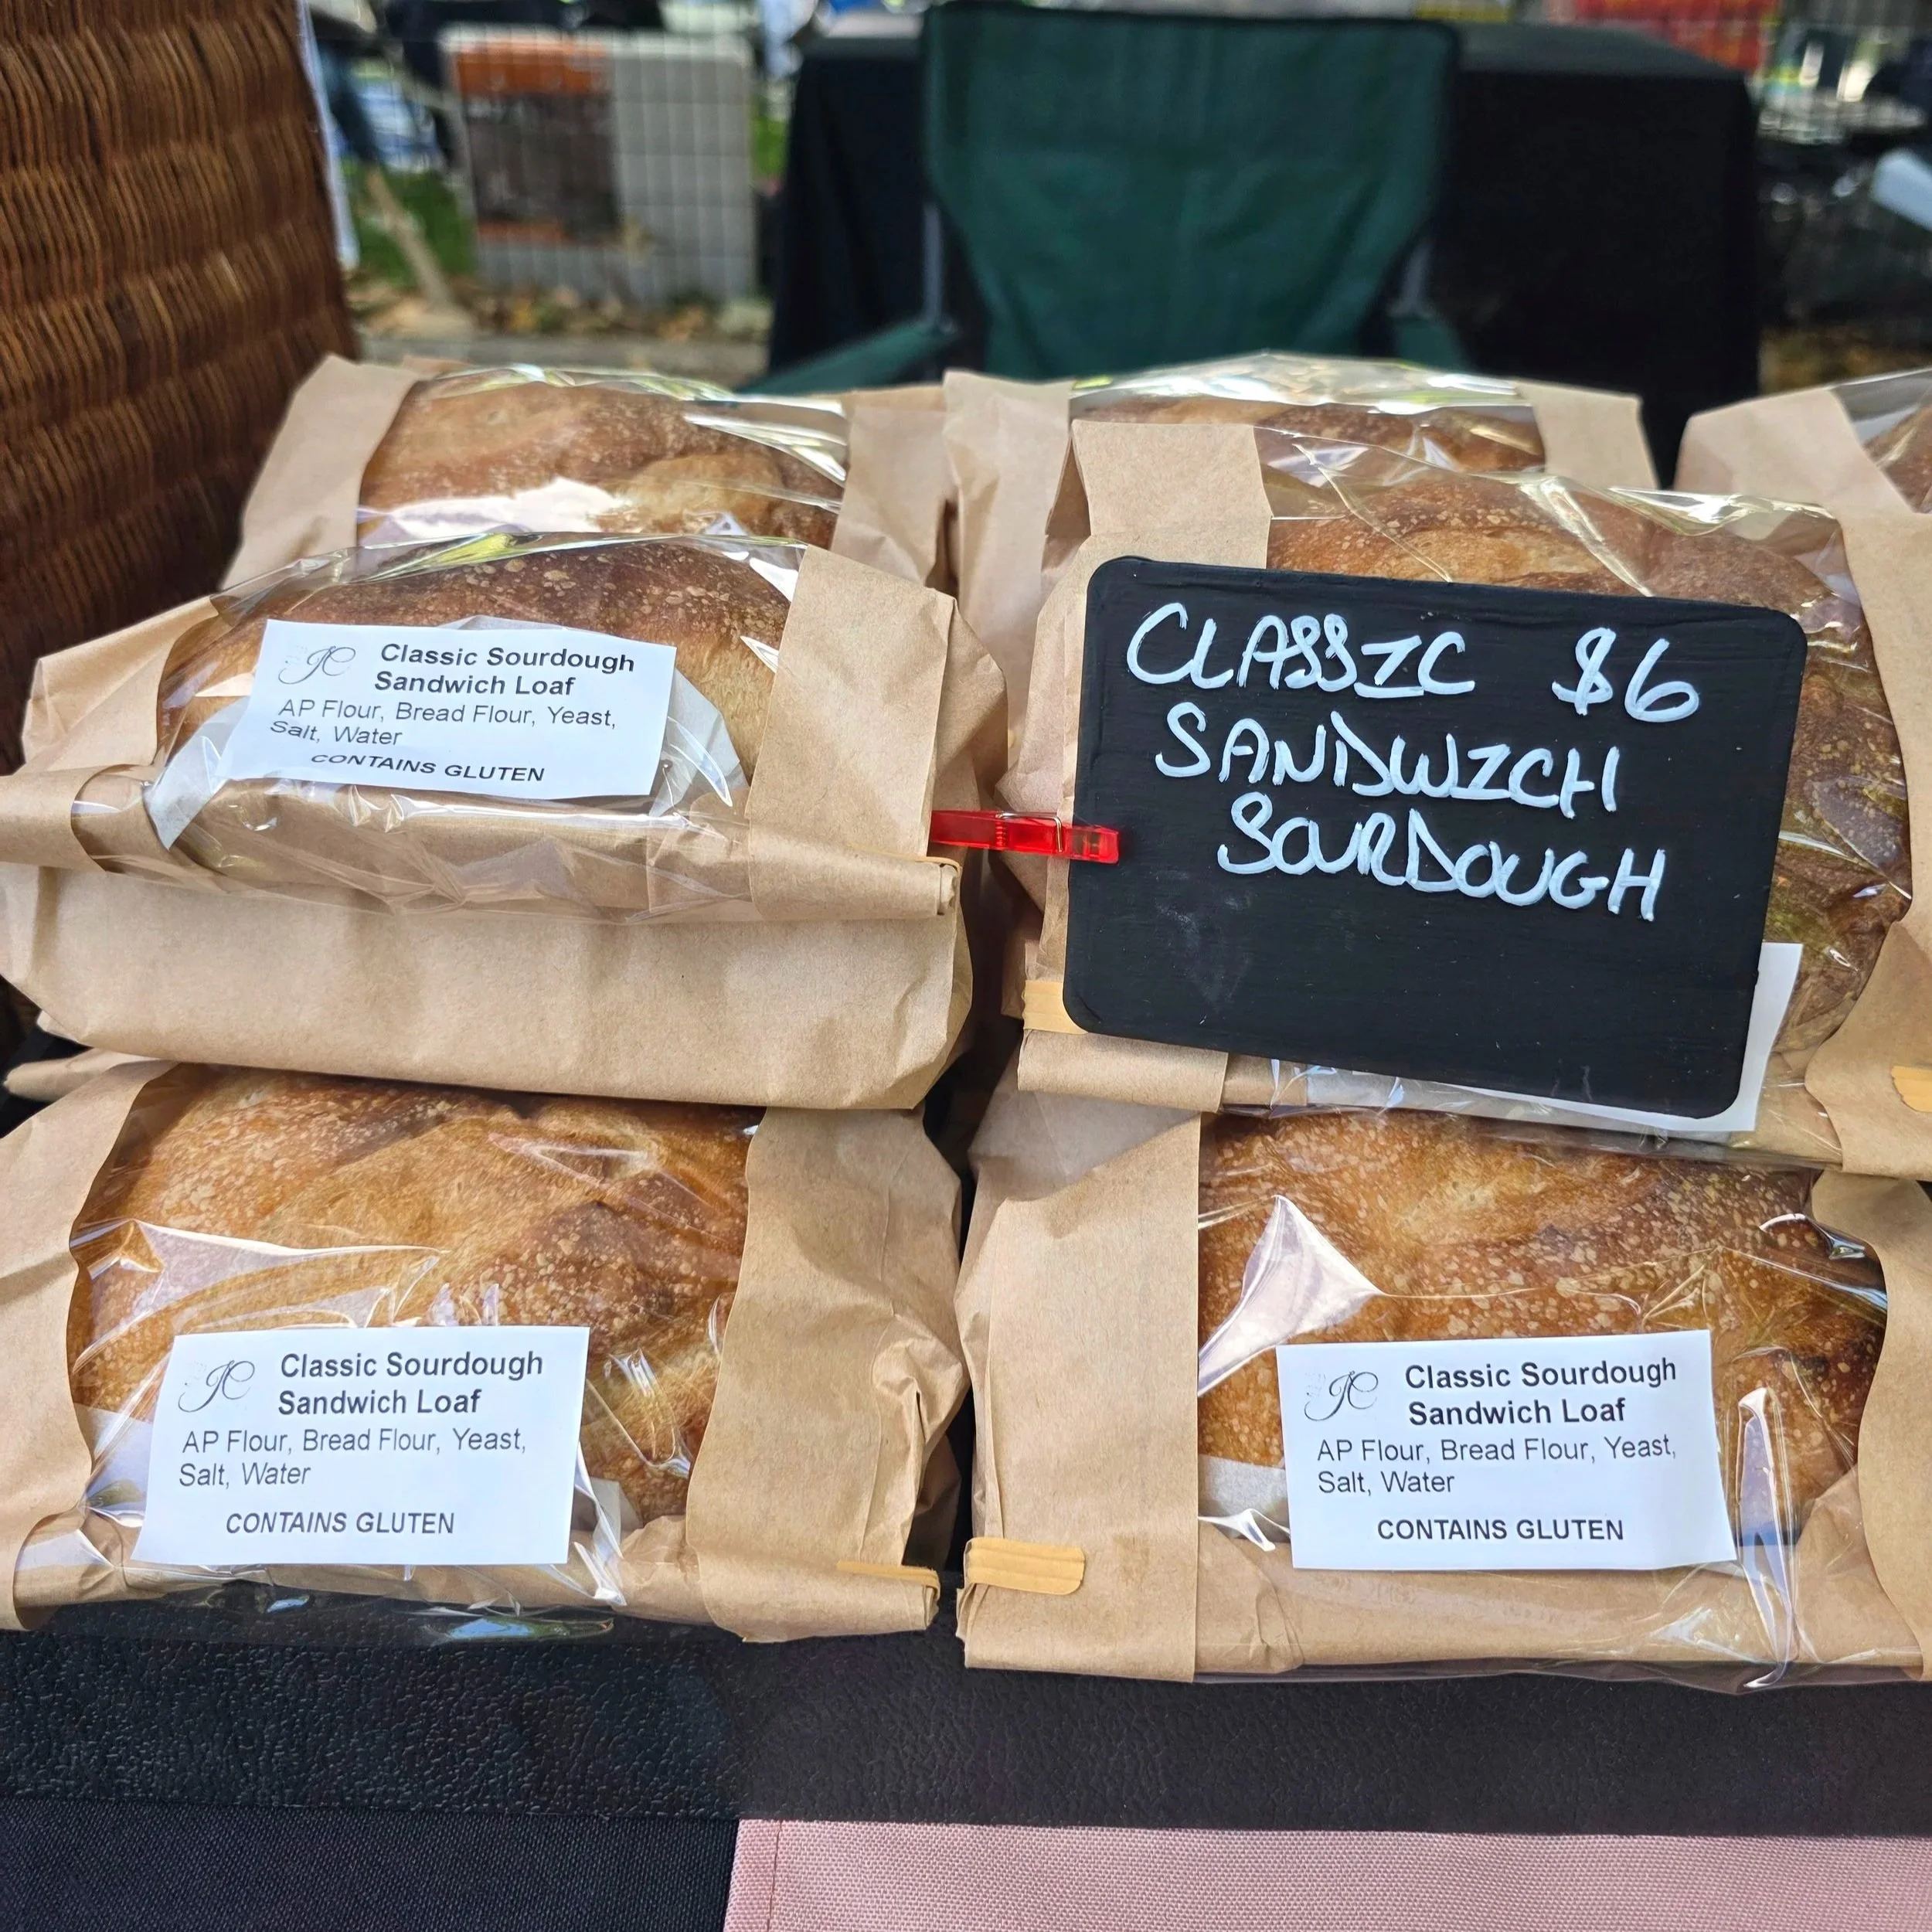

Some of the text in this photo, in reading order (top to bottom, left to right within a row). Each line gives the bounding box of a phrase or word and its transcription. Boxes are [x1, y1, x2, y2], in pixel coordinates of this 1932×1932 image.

[381, 643, 634, 674] Classic Sourdough
[1127, 602, 1700, 722] CLASSIC $6
[375, 671, 576, 696] Sandwich Loaf
[278, 699, 616, 730] AP Flour, Bread Flour, Yeast,
[270, 720, 403, 746] Salt, Water
[311, 753, 544, 781] CONTAINS GLUTEN
[1155, 701, 1621, 818] SANDWICH
[1218, 791, 1665, 921] SOURDOUGH
[281, 1350, 543, 1381] Classic Sourdough
[1405, 1357, 1675, 1389] Classic Sourdough
[278, 1389, 482, 1415] Sandwich Loaf
[1409, 1397, 1625, 1425] Sandwich Loaf
[182, 1427, 526, 1454] AP Flour, Bread Flour, Yeast,
[1318, 1434, 1675, 1464] AP Flour, Bread Flour, Yeast,
[179, 1462, 311, 1489] Salt, Water
[1318, 1471, 1454, 1496] Salt, Water
[226, 1512, 454, 1534] CONTAINS GLUTEN
[1377, 1519, 1623, 1540] CONTAINS GLUTEN
